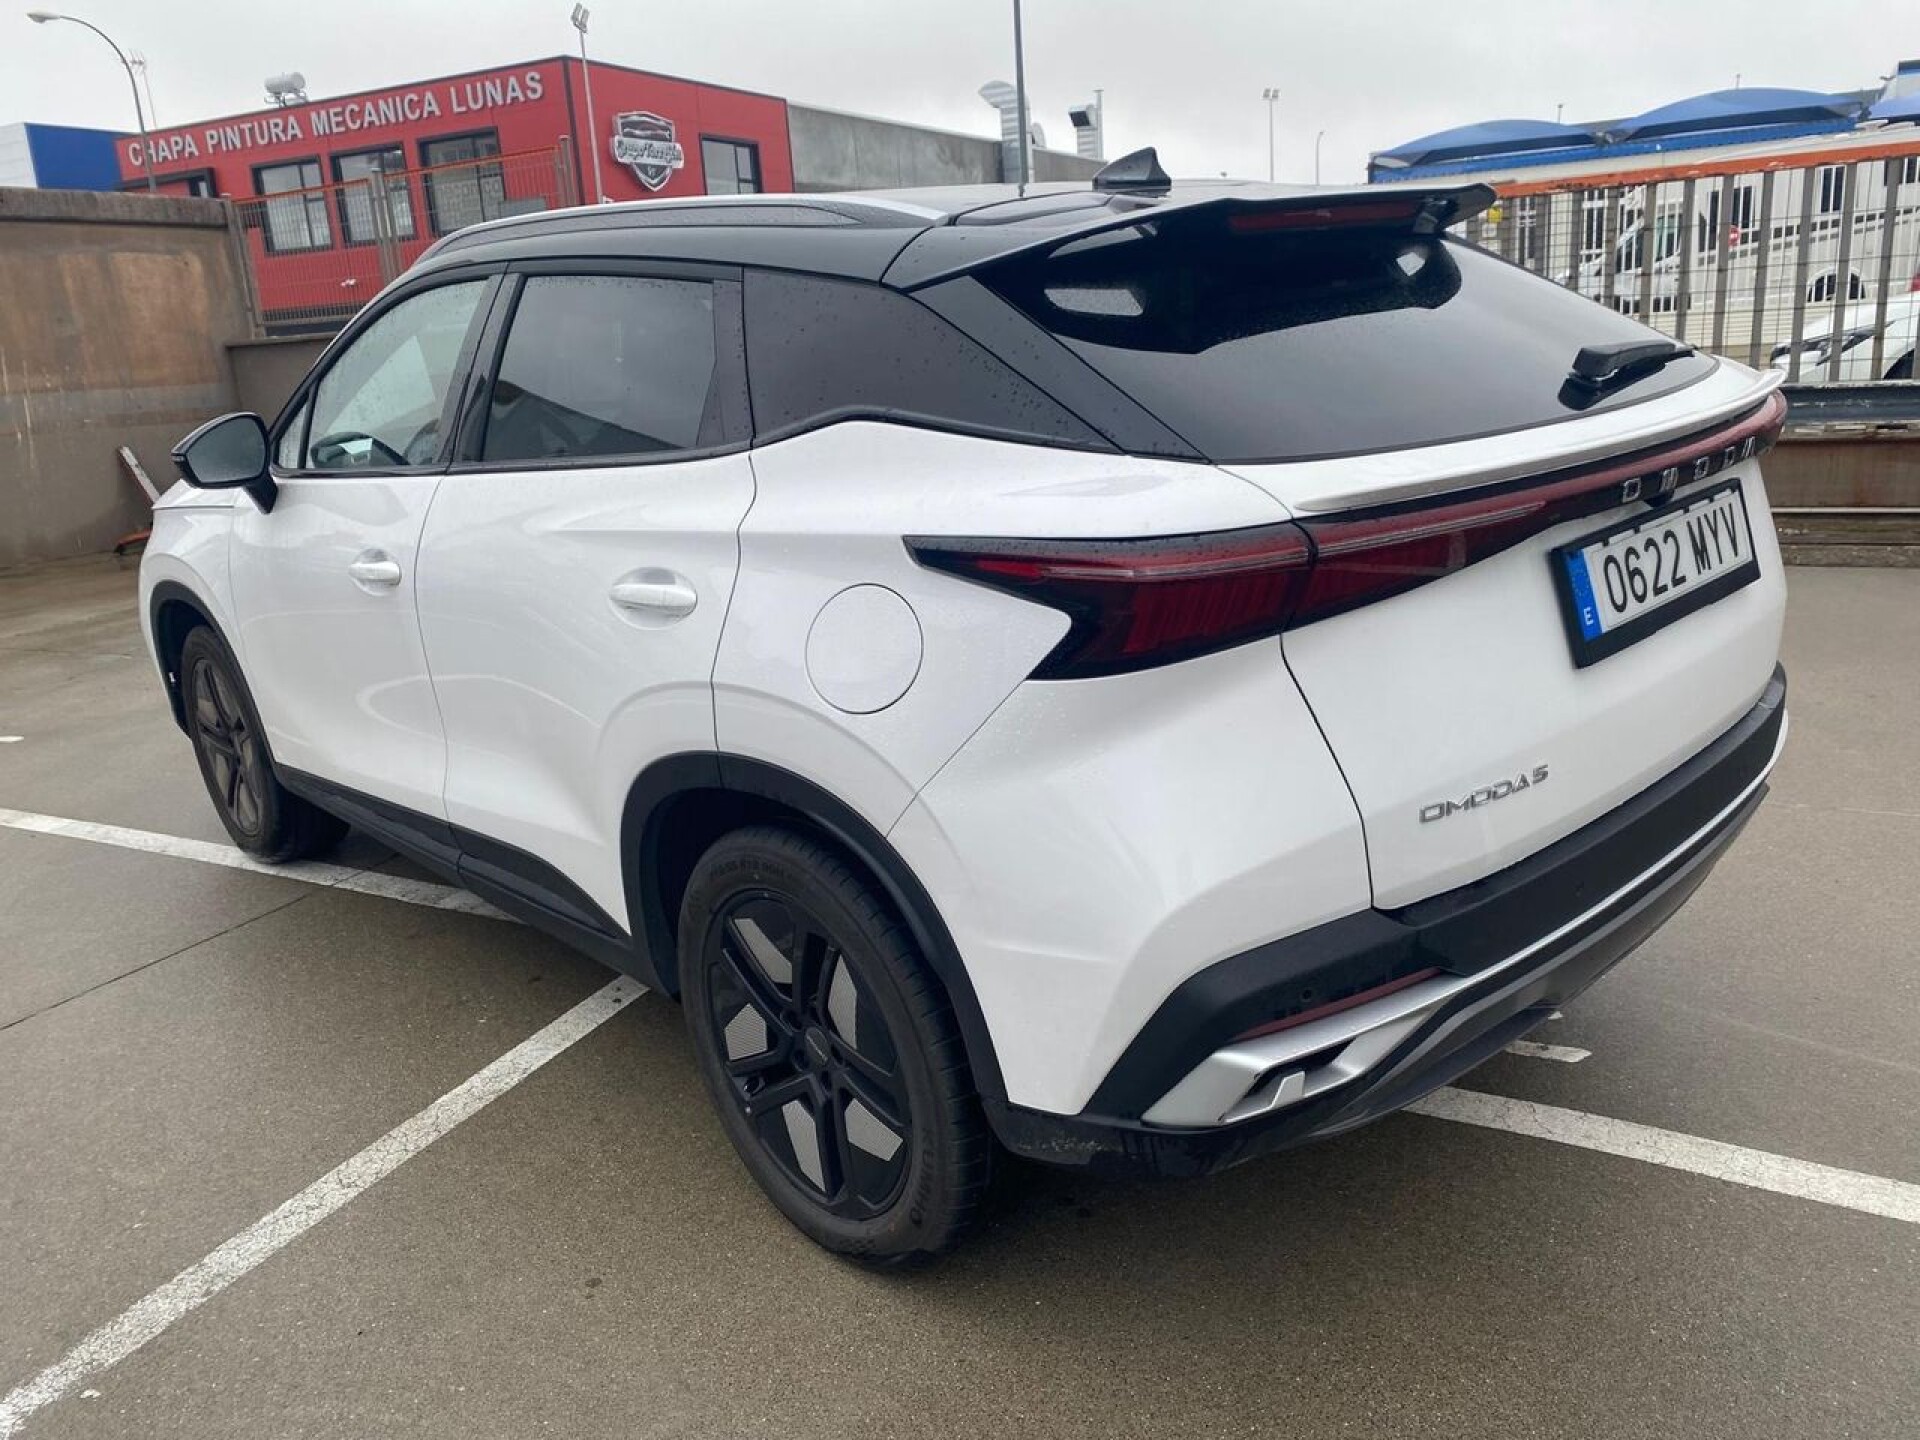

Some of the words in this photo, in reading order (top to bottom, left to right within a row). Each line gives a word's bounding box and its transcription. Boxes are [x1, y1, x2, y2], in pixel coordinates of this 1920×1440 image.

[205, 115, 303, 153] PINTURA
[311, 90, 441, 136] MECANICA
[449, 71, 543, 114] LUNAS
[1604, 529, 1686, 612] 0622
[1687, 502, 1739, 575] MYV
[1583, 606, 1594, 626] E
